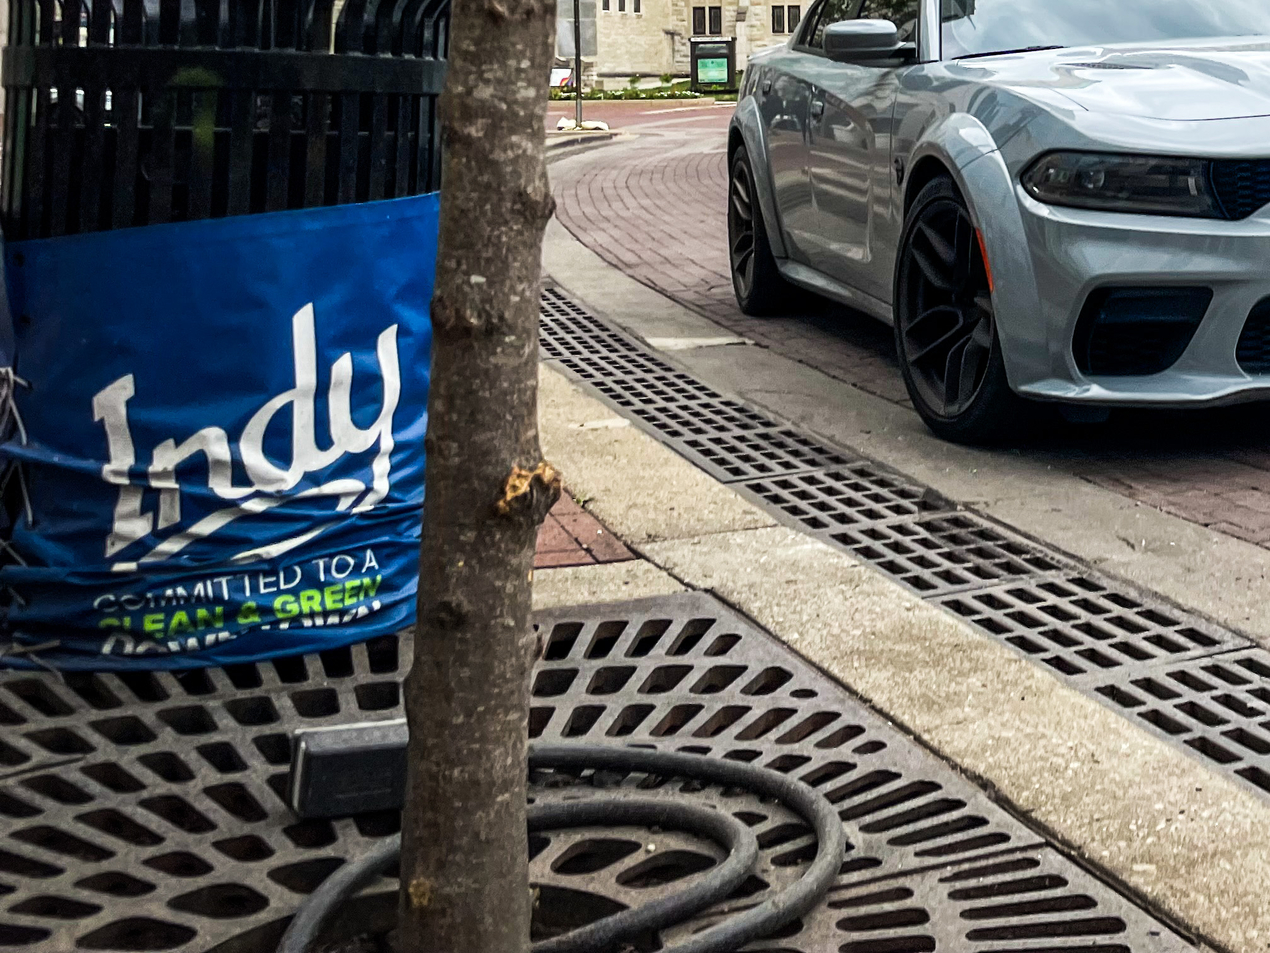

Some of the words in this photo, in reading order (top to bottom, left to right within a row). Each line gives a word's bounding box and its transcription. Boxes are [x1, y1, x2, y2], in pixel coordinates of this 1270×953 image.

[92, 301, 402, 559] Indy
[313, 554, 355, 581] TO
[361, 548, 380, 573] A
[237, 601, 261, 625] &
[273, 575, 382, 620] GREEN
